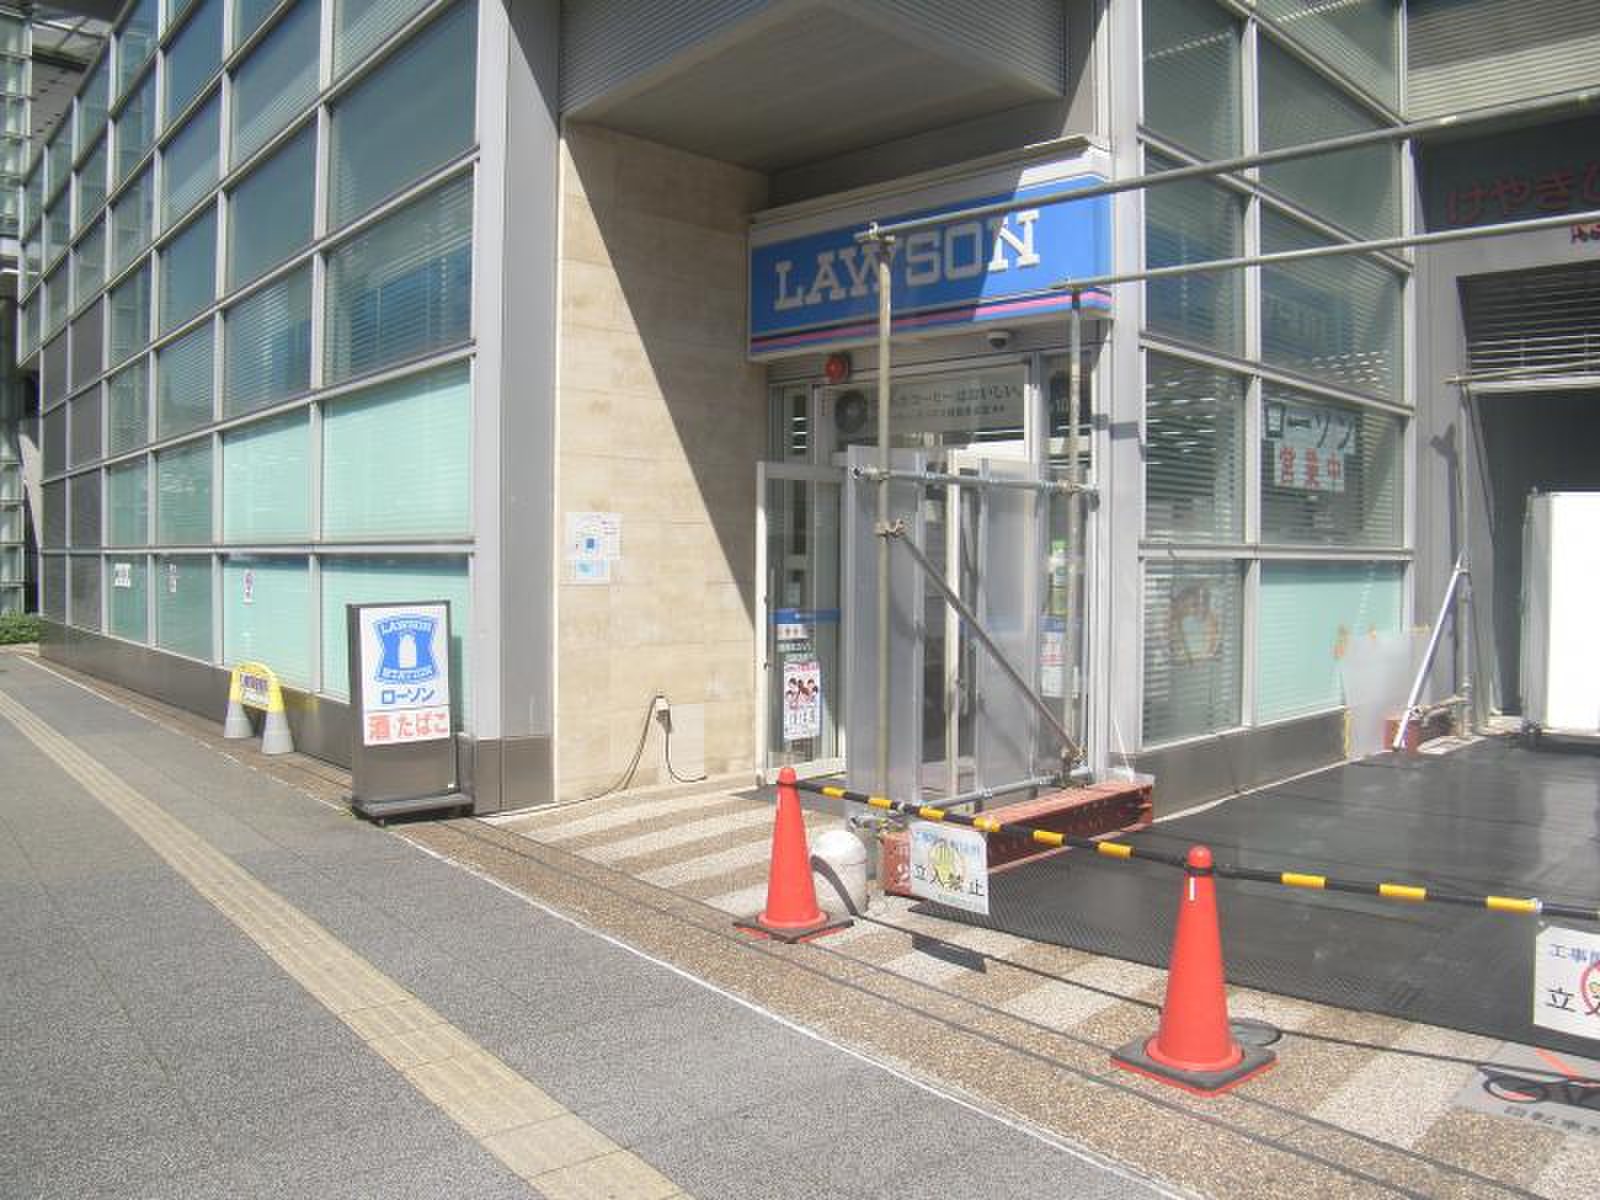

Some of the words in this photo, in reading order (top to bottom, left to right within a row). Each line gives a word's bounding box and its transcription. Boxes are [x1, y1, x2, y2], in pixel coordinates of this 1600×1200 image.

[774, 208, 1041, 311] LAWSON
[1263, 401, 1354, 450] ローソン
[1279, 446, 1343, 490] 営業中
[381, 687, 435, 705] ローソン
[398, 711, 449, 738] たばこ
